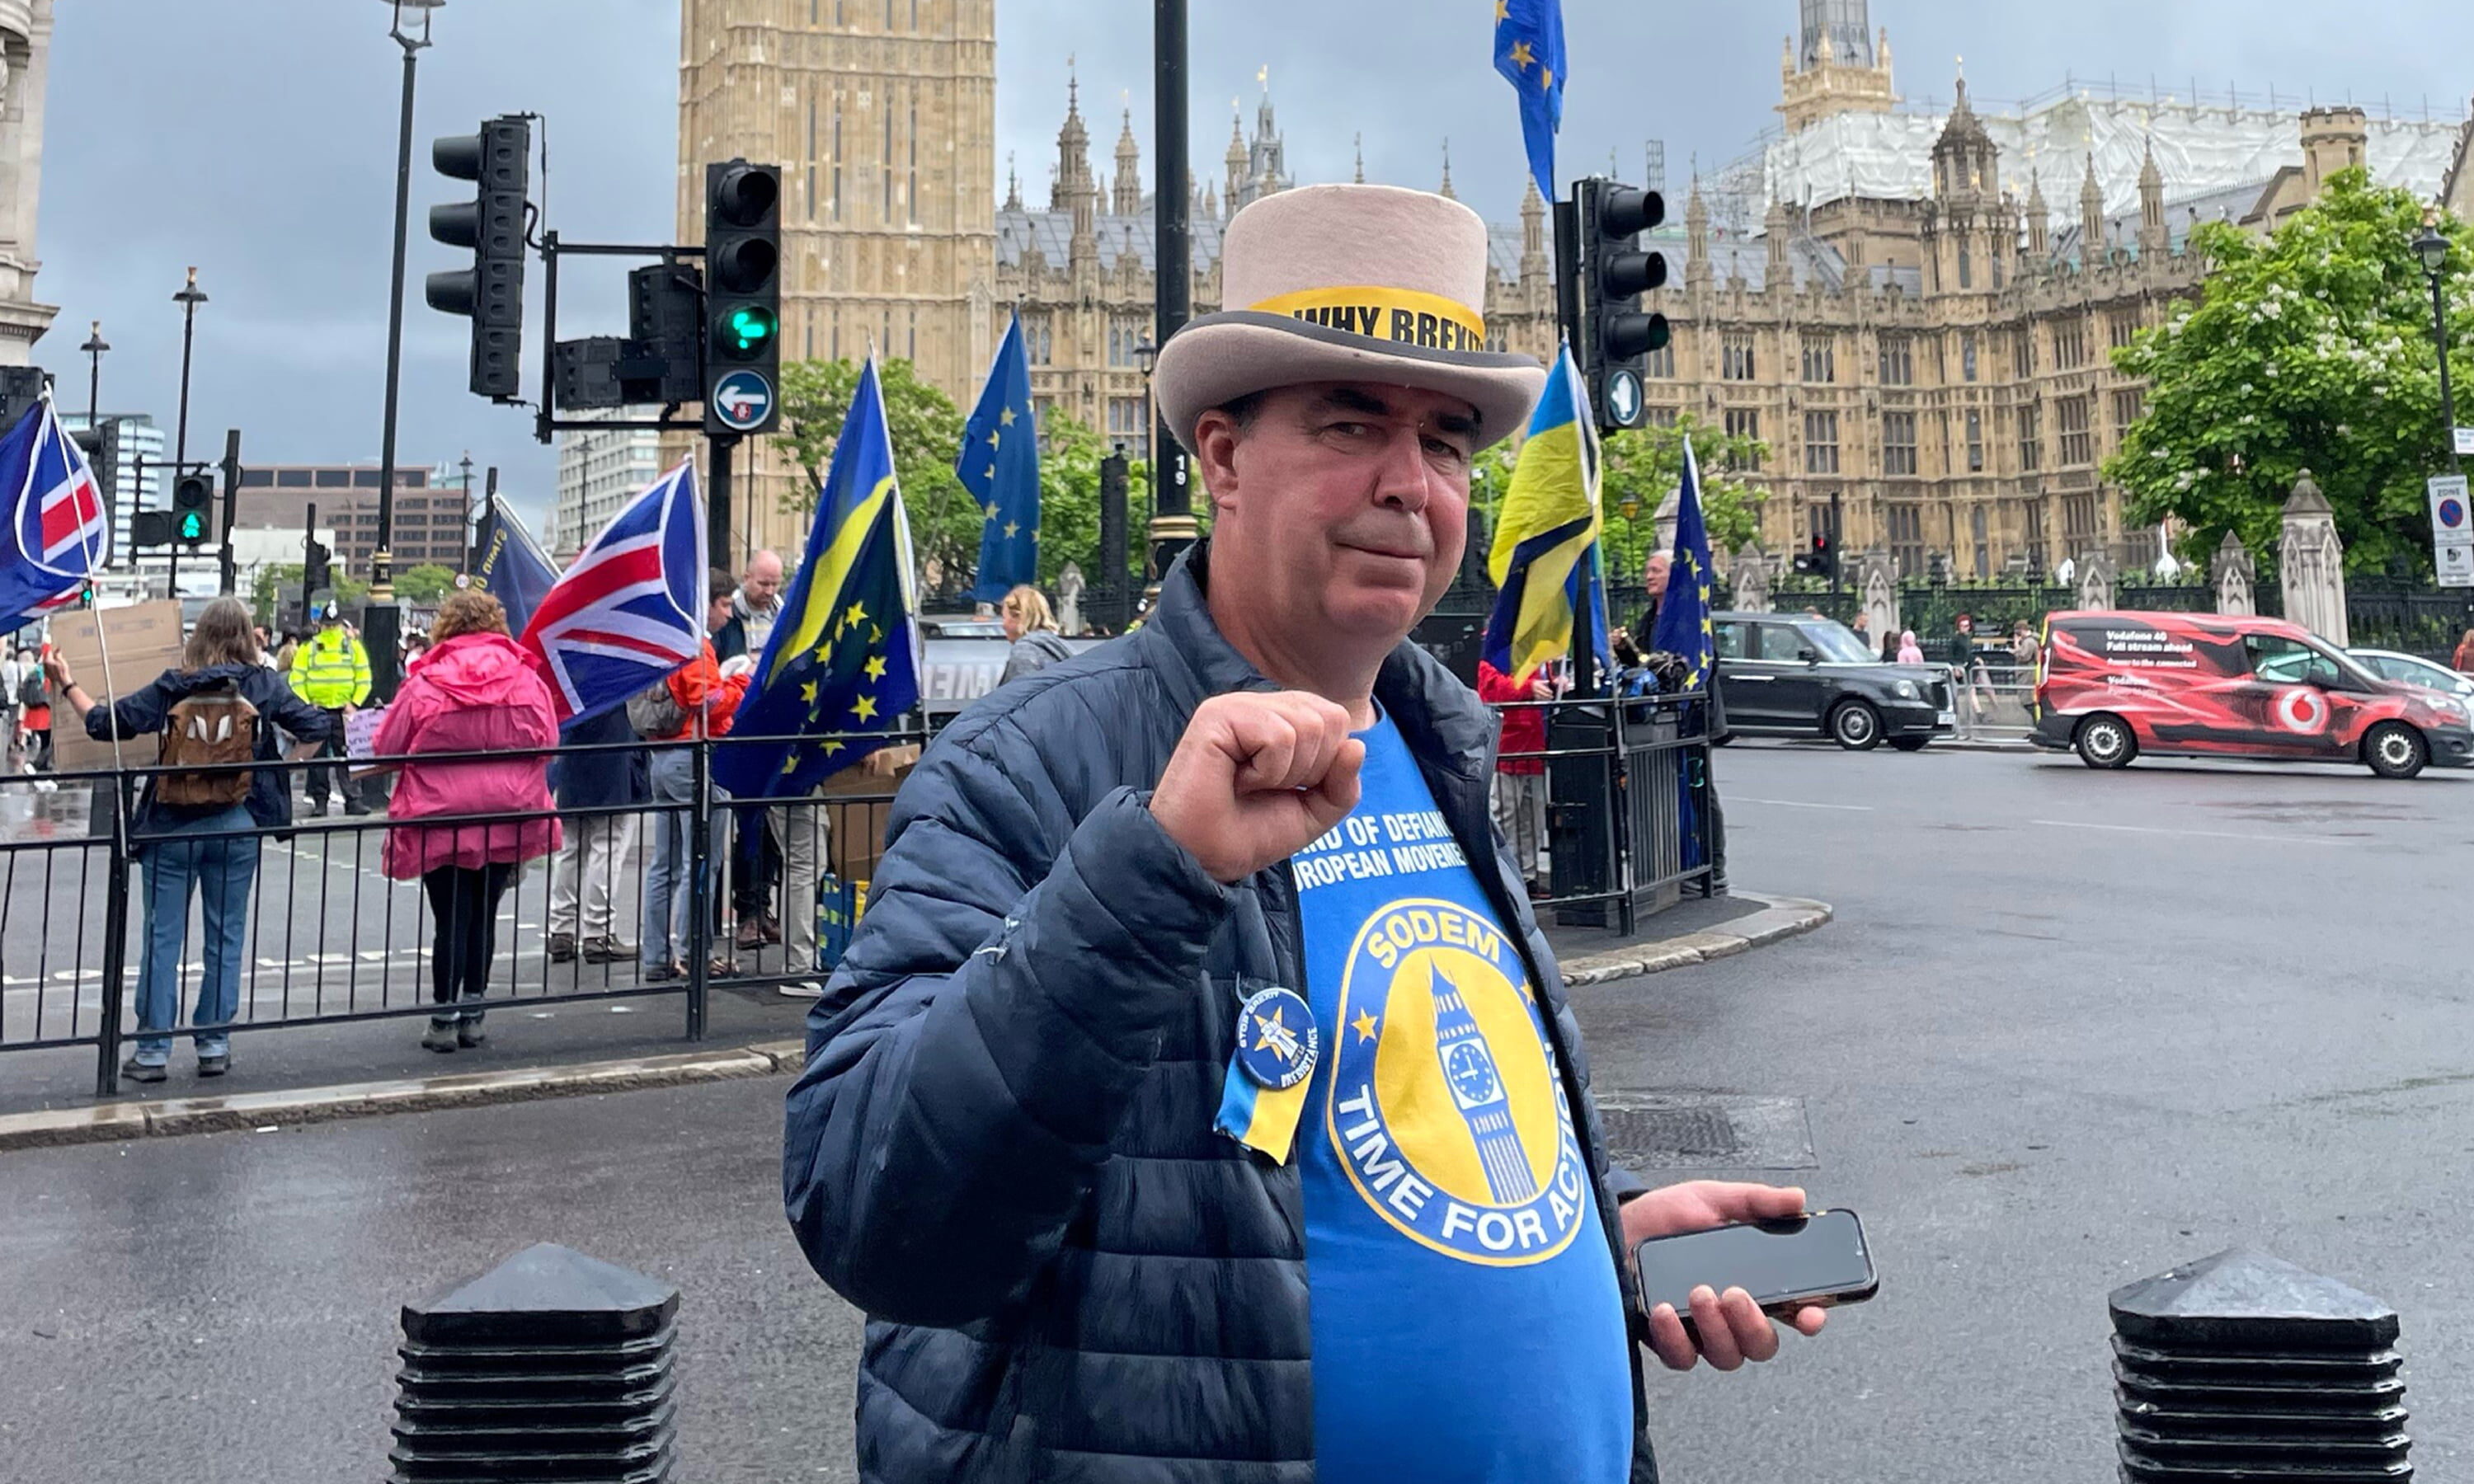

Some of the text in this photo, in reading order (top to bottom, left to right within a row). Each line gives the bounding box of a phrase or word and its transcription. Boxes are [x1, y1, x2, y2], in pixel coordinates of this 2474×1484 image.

[2105, 630, 2152, 641] Vodafone
[2128, 643, 2163, 652] stream
[2163, 643, 2194, 653] ahead
[1345, 815, 1380, 847] OF
[1381, 810, 1455, 843] DEFIANC
[1292, 842, 1469, 892] UROPEAN MOVEME
[1366, 910, 1500, 970] SODEM
[1338, 1084, 1434, 1222] TIME
[1442, 1201, 1549, 1252] FOR
